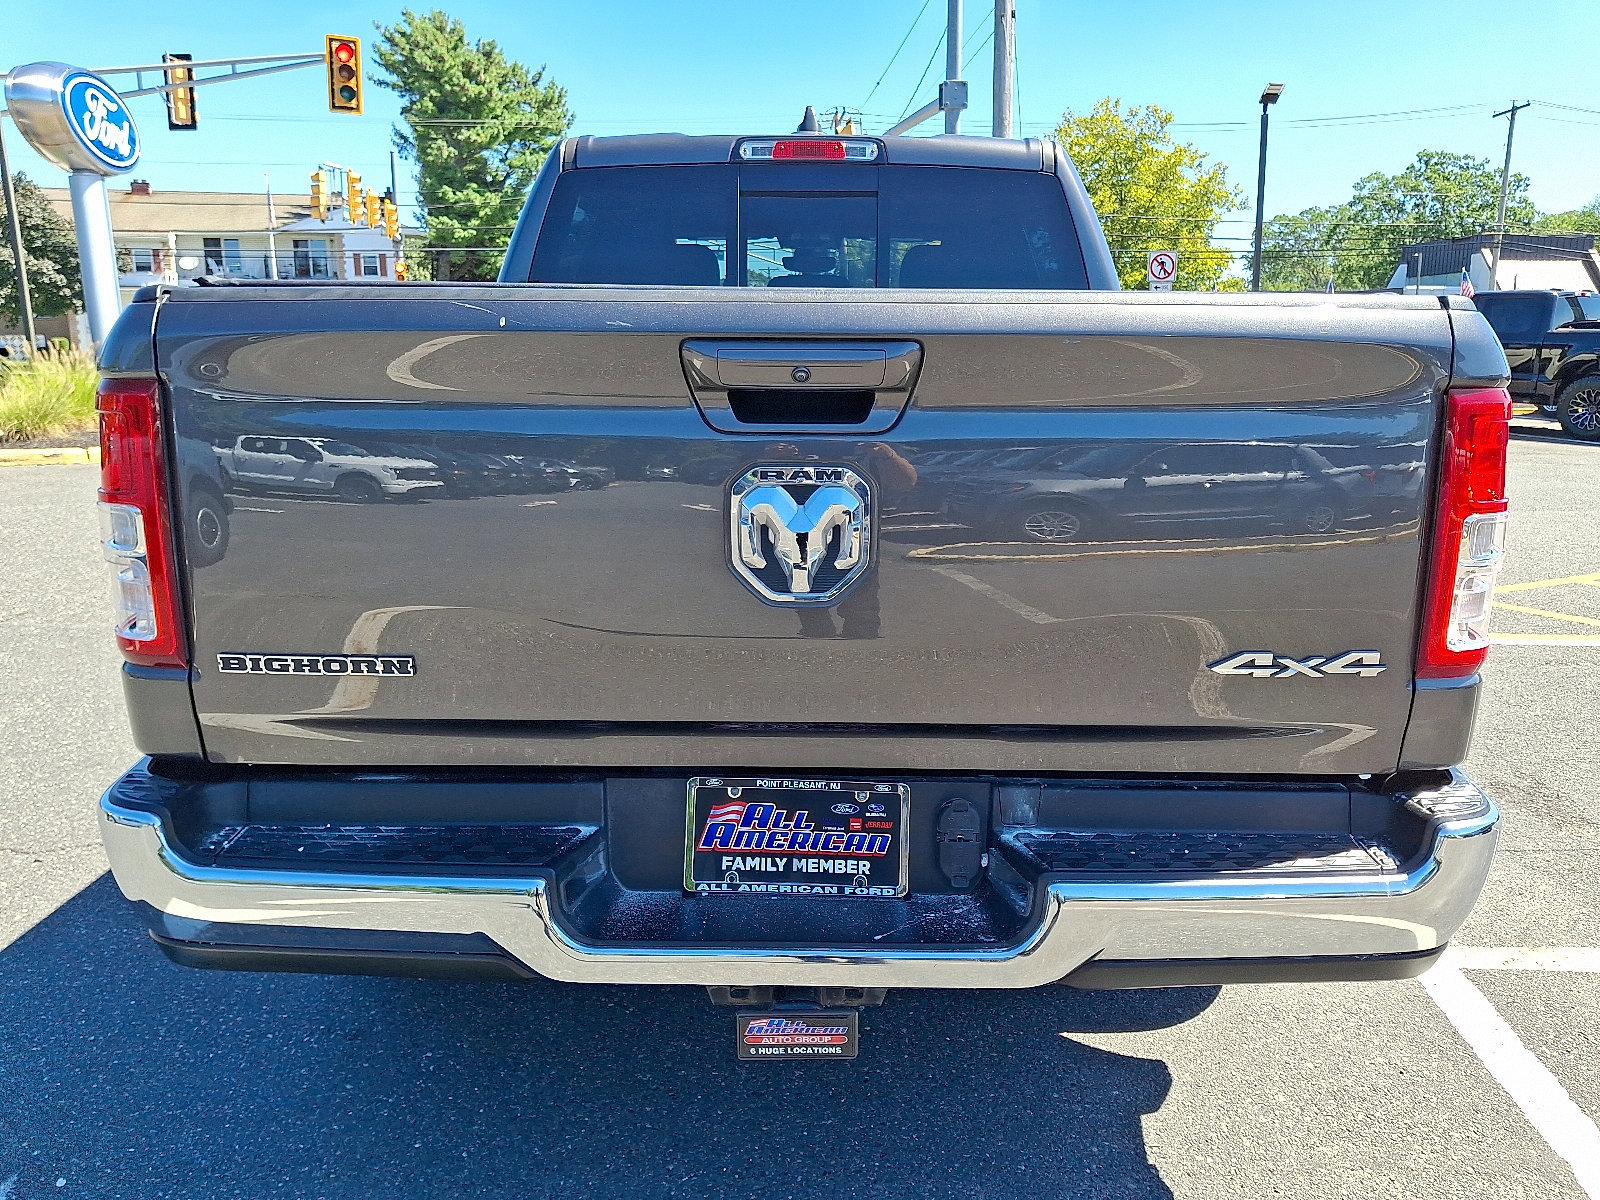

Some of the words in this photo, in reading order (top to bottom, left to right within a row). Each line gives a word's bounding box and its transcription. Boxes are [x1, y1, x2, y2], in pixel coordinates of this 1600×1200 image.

[82, 87, 132, 158] Ford
[759, 469, 843, 481] RAM
[216, 653, 416, 677] BIGHORN
[756, 779, 782, 788] POINT
[783, 780, 828, 790] PLEASANT,
[830, 782, 841, 790] NJ
[722, 856, 788, 871] FAMILY
[792, 858, 871, 875] MEMBER
[697, 883, 732, 891] ALL
[738, 884, 838, 894] AMERICAN
[844, 887, 896, 896] FORD
[761, 1036, 792, 1044] AUTO
[749, 1047, 757, 1055] 6
[759, 1047, 786, 1055] HUGE
[787, 1046, 842, 1055] LOCATIONS
